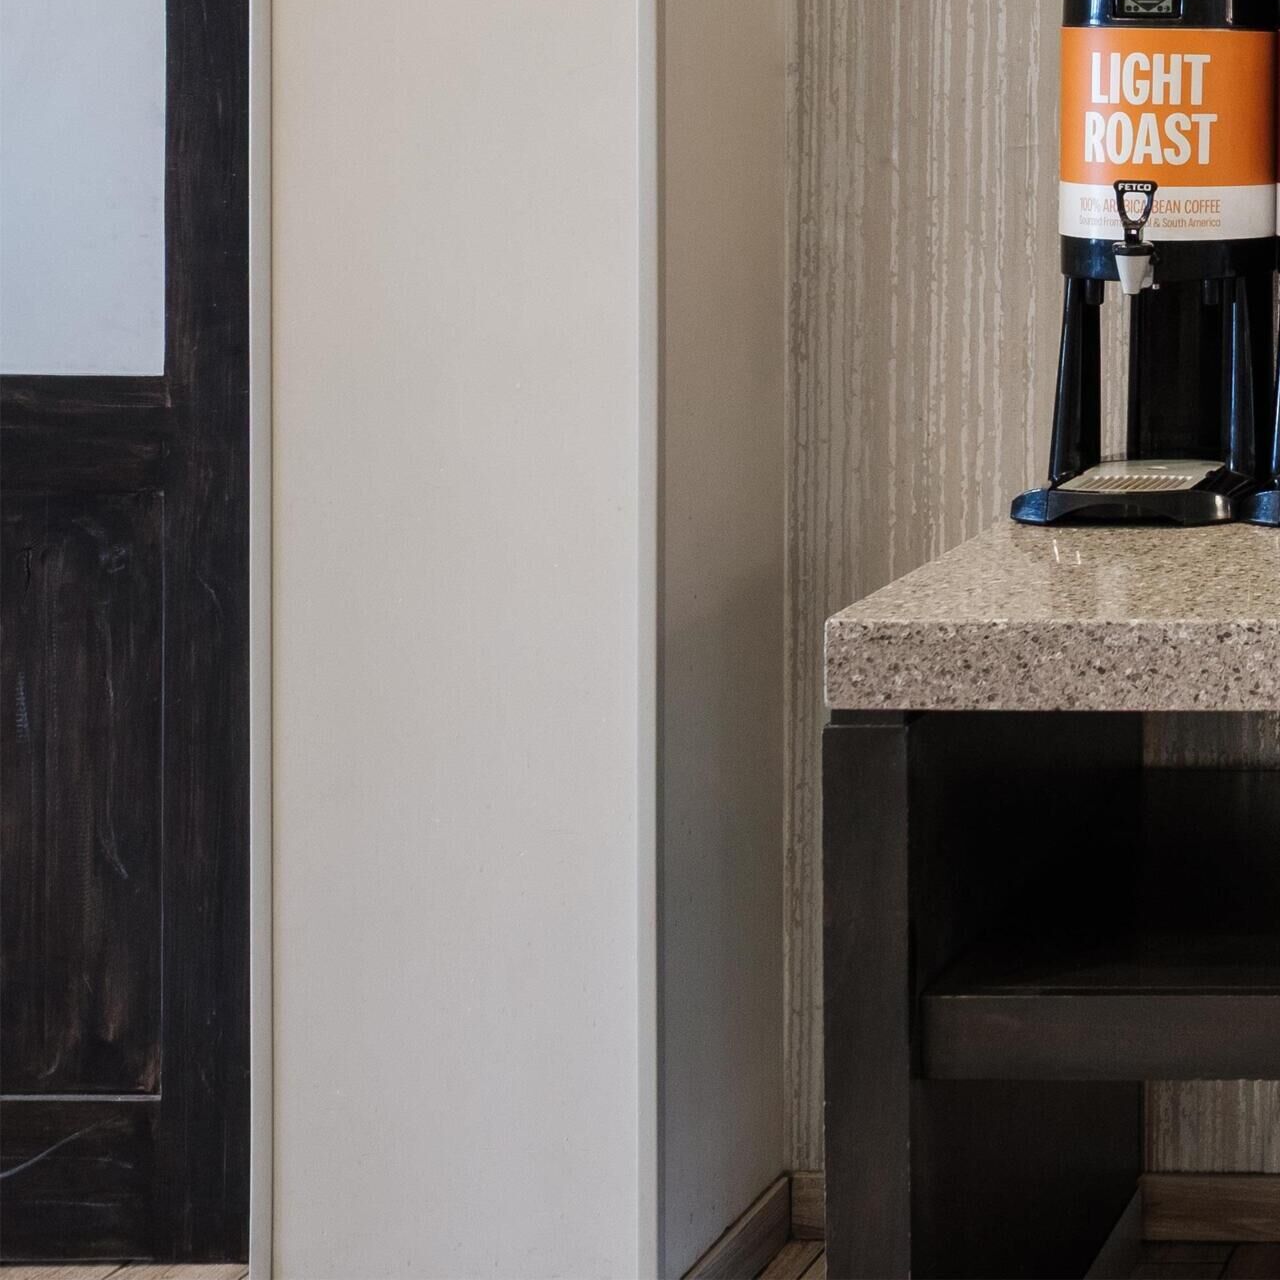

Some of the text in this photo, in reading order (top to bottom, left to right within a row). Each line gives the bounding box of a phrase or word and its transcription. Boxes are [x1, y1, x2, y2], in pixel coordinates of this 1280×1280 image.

[1091, 52, 1211, 105] LIGHT
[1084, 111, 1218, 165] ROAST
[1118, 183, 1152, 191] FETCO
[1151, 200, 1181, 214] BEAN
[1184, 199, 1221, 214] COFFEE
[1188, 216, 1221, 228] America
